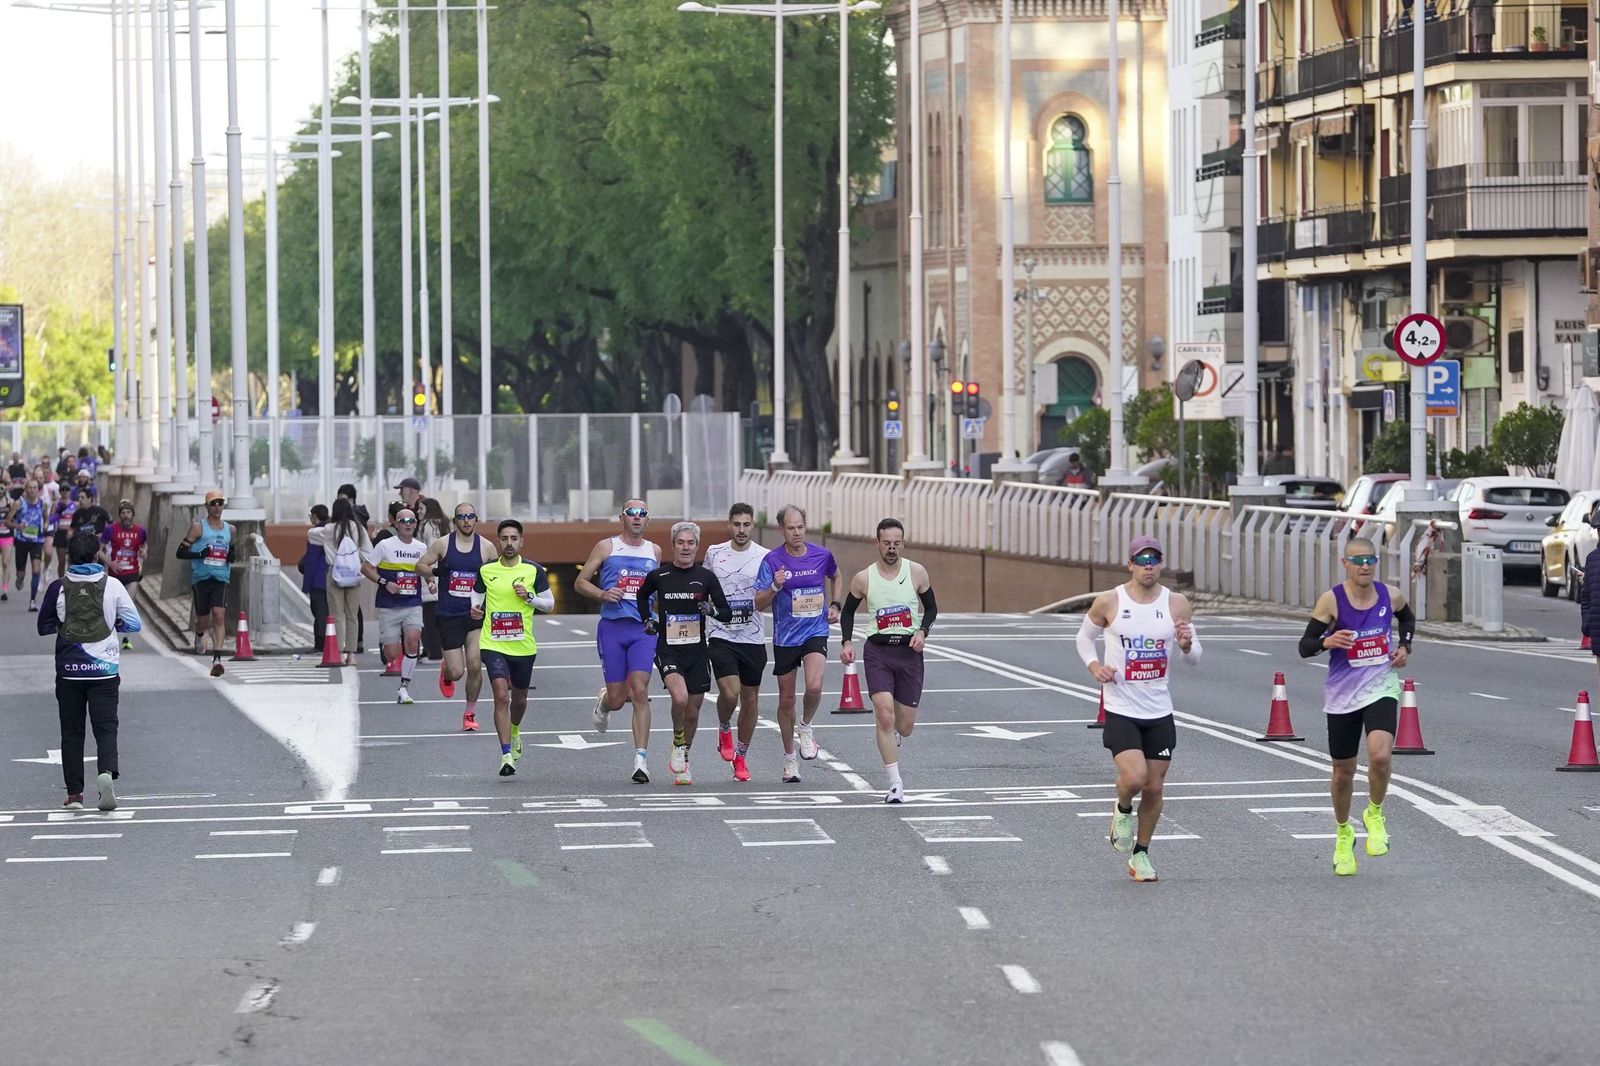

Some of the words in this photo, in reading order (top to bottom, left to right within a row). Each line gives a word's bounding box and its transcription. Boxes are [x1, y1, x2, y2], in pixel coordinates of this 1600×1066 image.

[1555, 320, 1585, 329] LUIS
[1427, 365, 1449, 395] P
[795, 569, 817, 577] ZURICH
[887, 606, 907, 614] ZURICH
[1360, 628, 1383, 637] ZURICH
[1357, 647, 1382, 658] DAVID
[1131, 669, 1160, 679] POYATO
